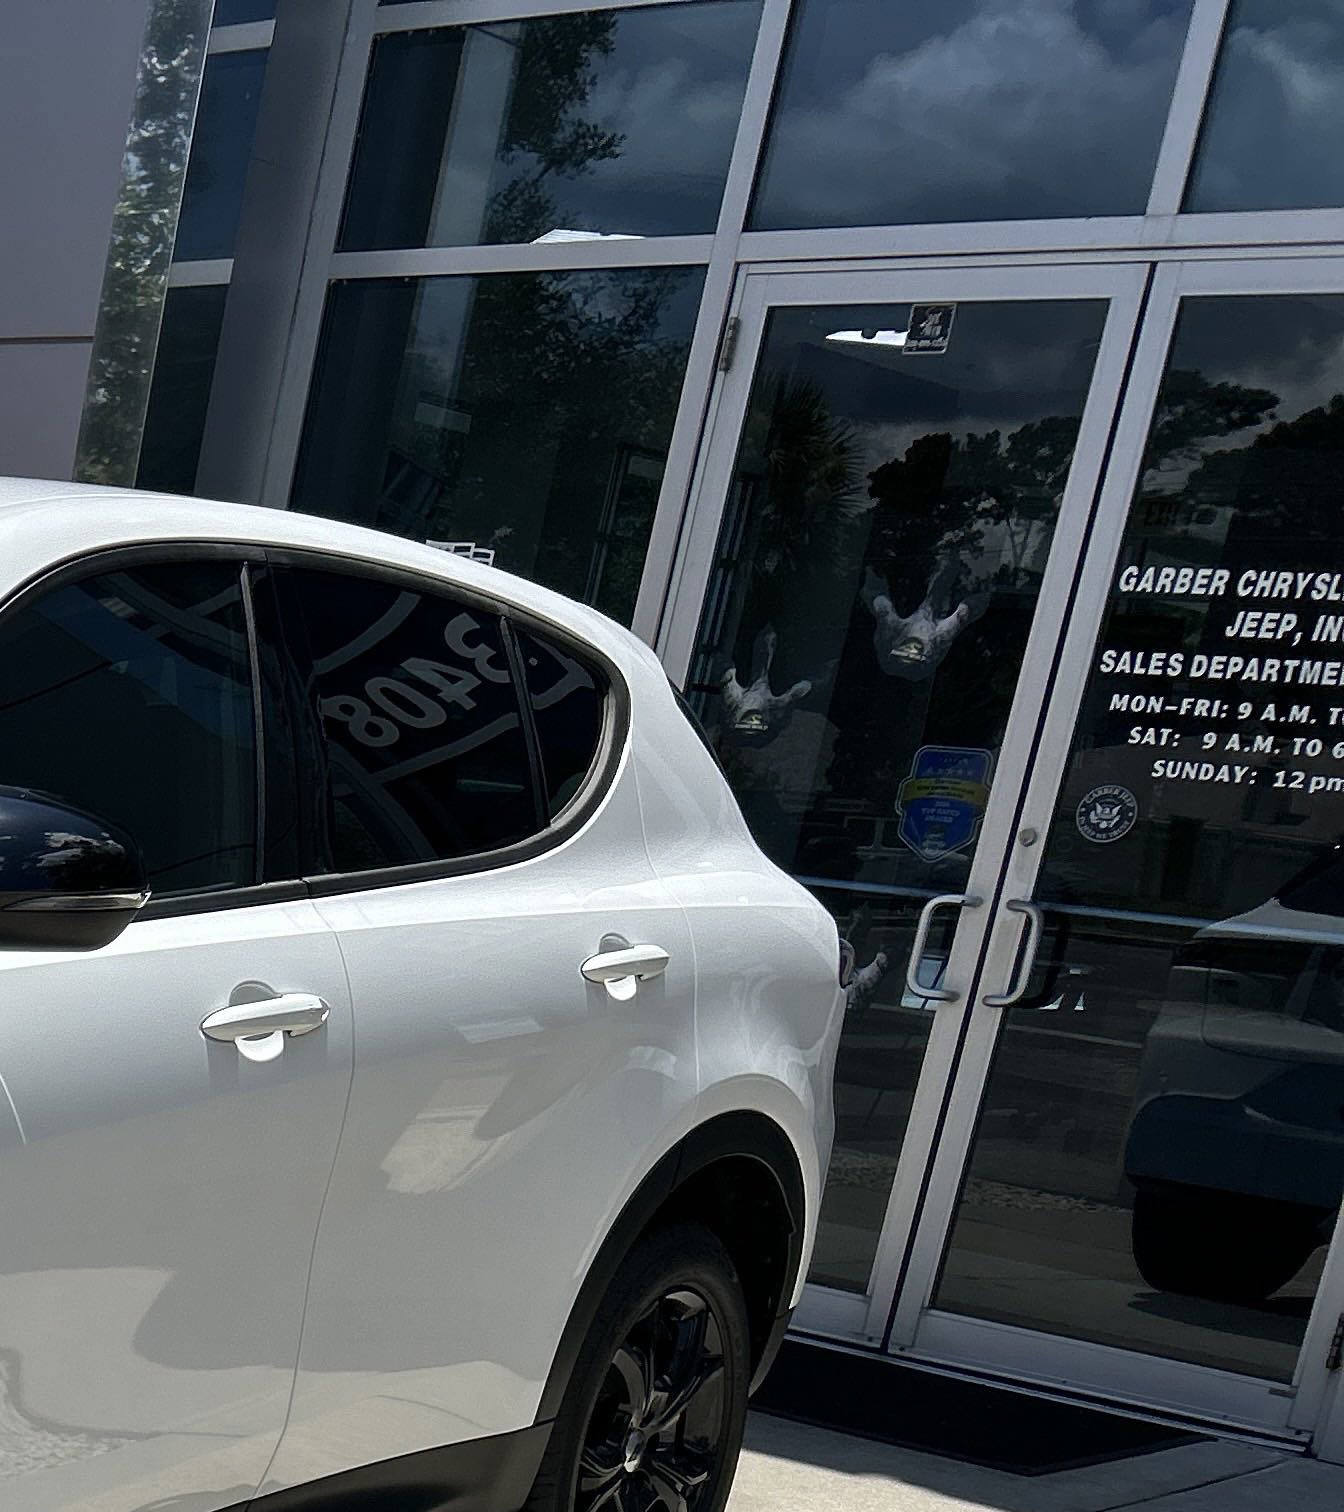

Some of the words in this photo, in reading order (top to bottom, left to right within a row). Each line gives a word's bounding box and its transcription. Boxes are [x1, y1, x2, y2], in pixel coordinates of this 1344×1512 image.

[1118, 565, 1230, 596] GARBER
[1237, 570, 1344, 601] CHRYSL
[1225, 611, 1303, 646] JEEP,
[1311, 614, 1344, 642] IN
[1100, 649, 1184, 677] SALES
[1237, 702, 1253, 720] 9
[1260, 703, 1317, 724] A.M.
[1329, 707, 1344, 725] T
[1127, 726, 1181, 747] SAT:
[1201, 732, 1217, 750] 9
[1224, 733, 1281, 755] A.M.
[1293, 737, 1322, 757] TO
[1151, 759, 1258, 785] SUNDAY:
